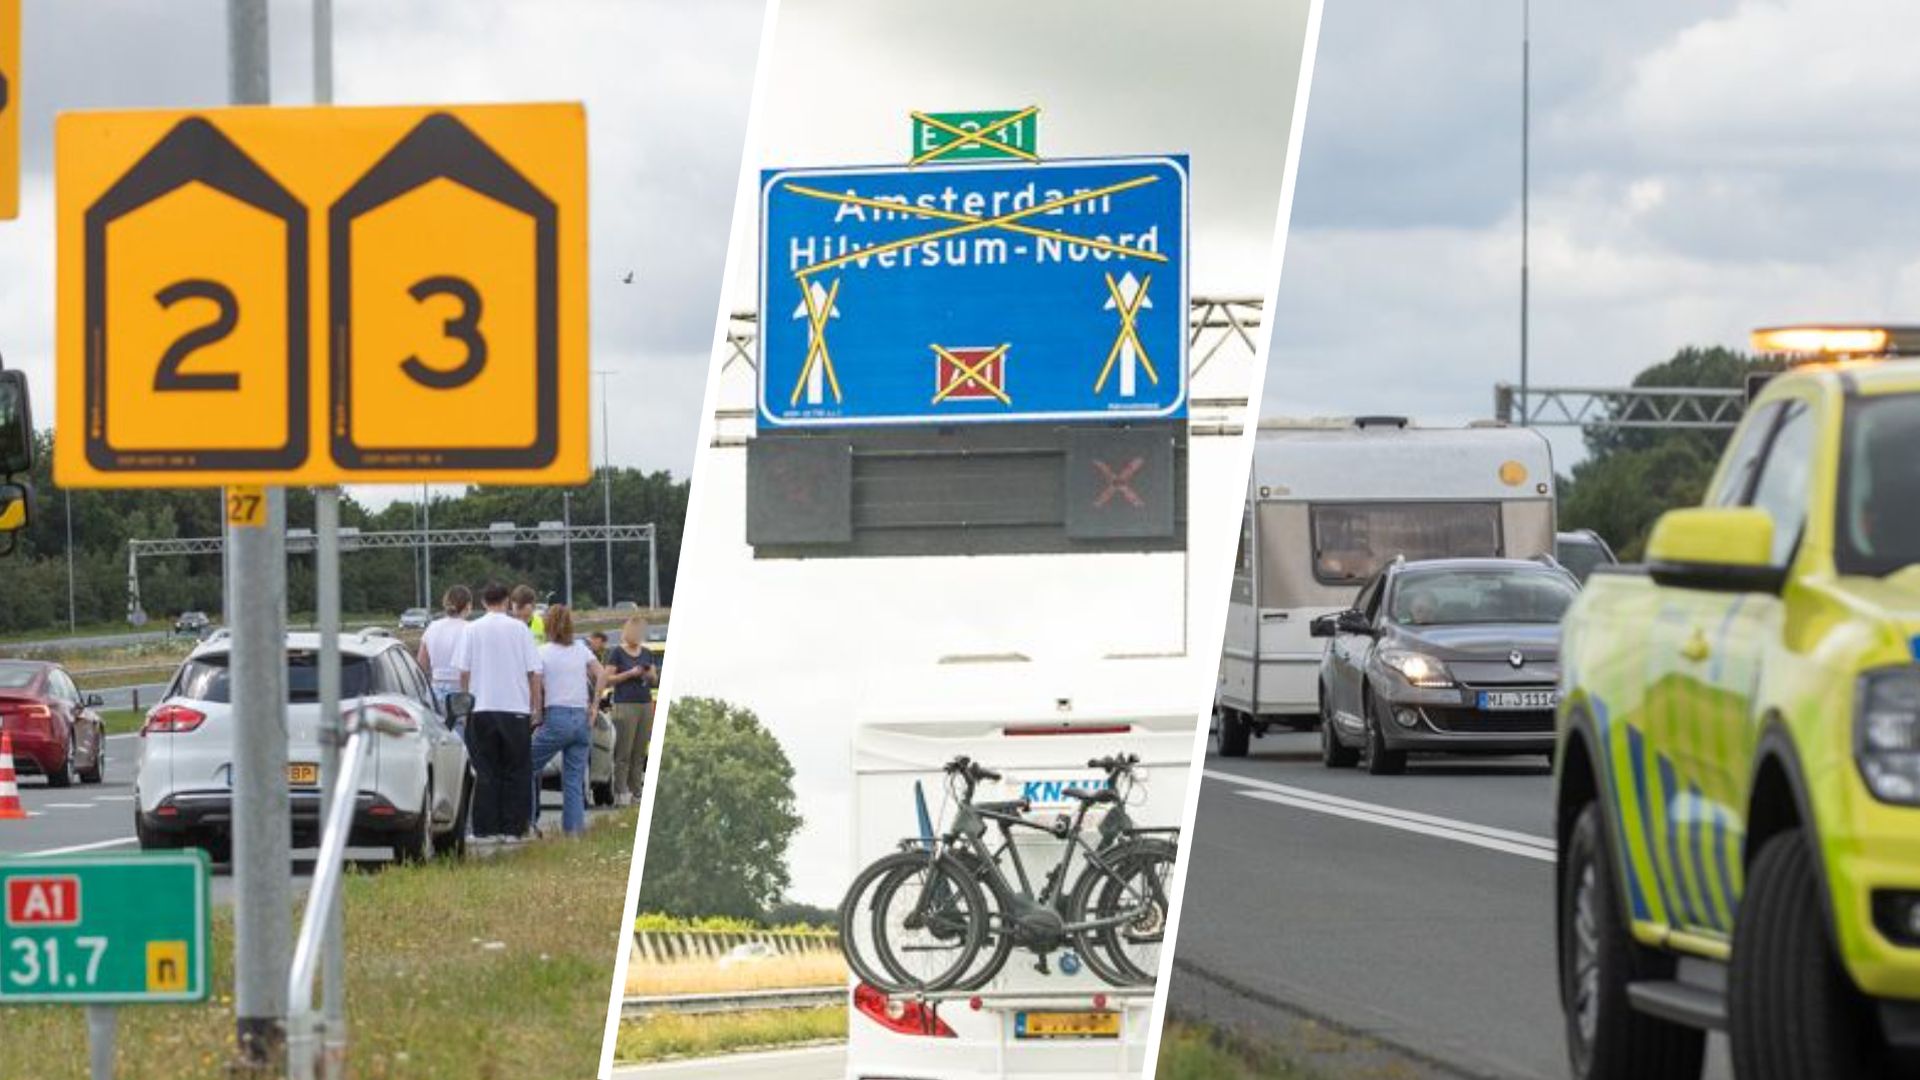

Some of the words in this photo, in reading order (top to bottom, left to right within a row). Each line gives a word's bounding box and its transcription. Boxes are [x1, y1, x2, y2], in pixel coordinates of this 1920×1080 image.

[834, 182, 1111, 223] Amsterdam
[790, 225, 1159, 271] Hilversum-Noord
[152, 278, 240, 392] 2
[400, 275, 488, 390] 3
[230, 494, 261, 521] 27
[23, 883, 64, 919] A1
[10, 936, 108, 987] 31.7
